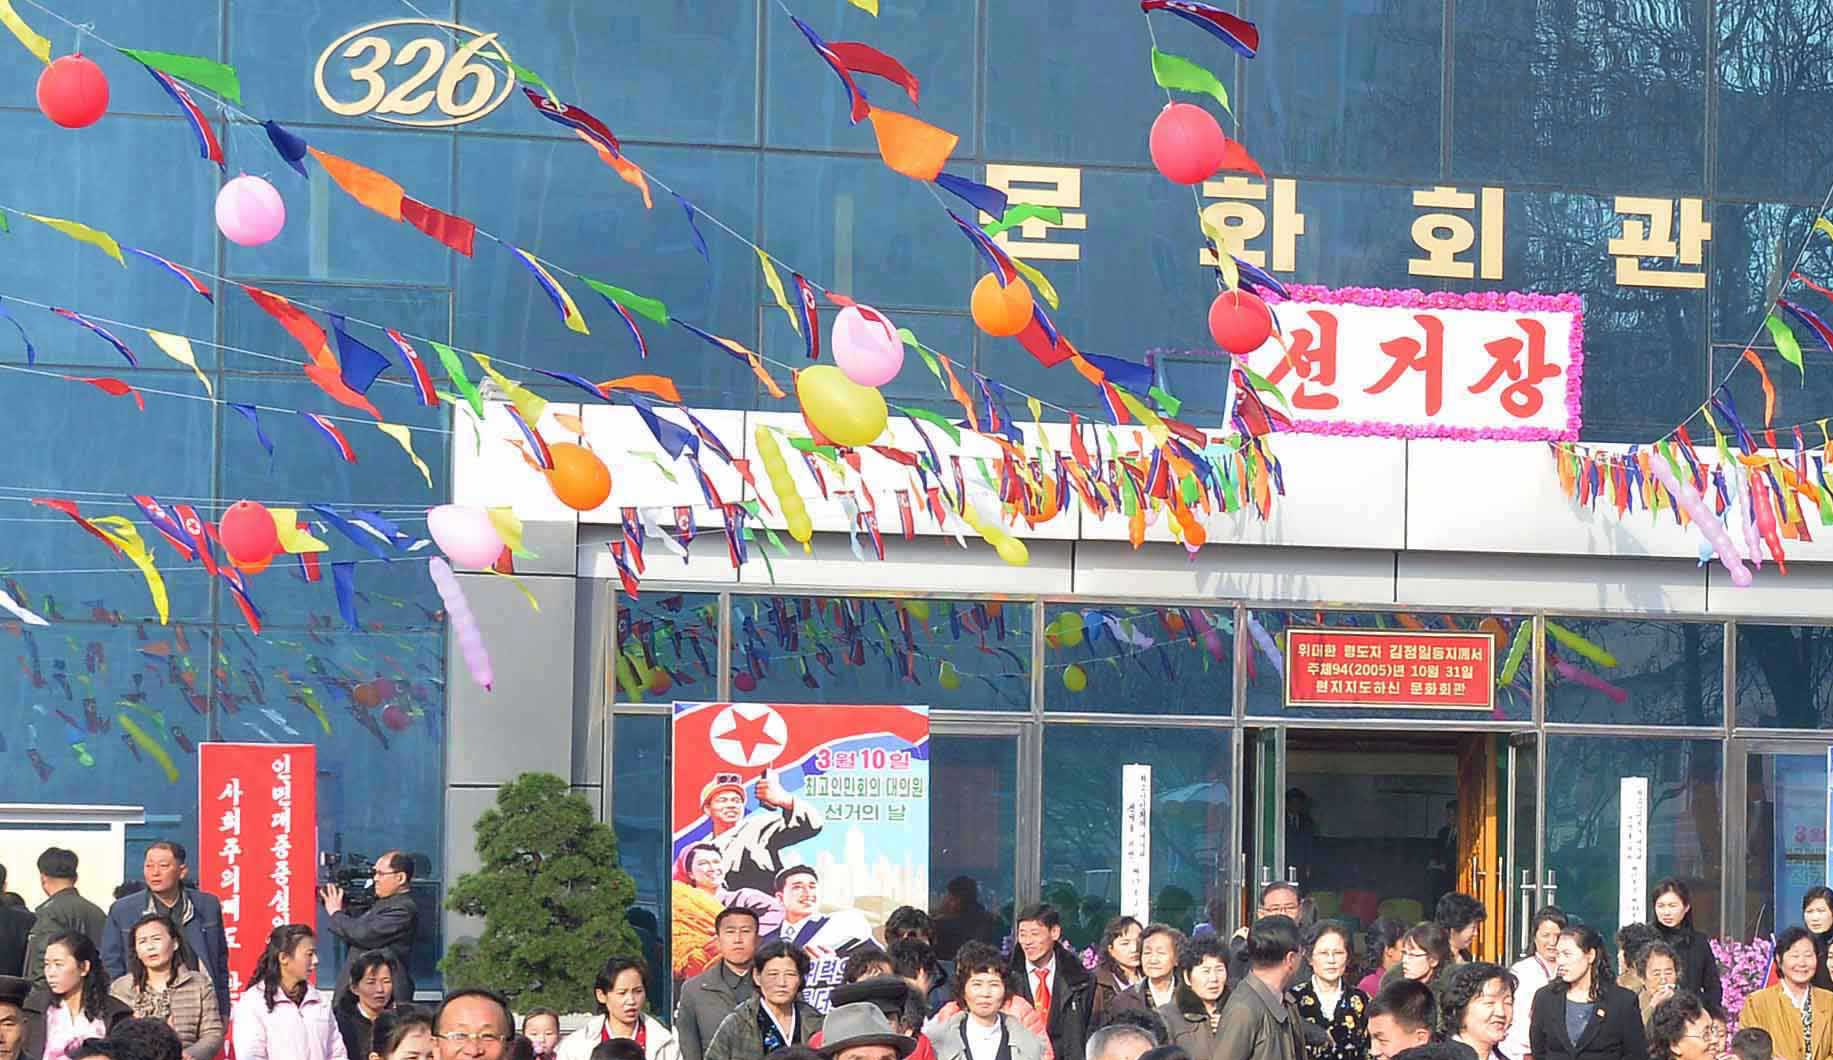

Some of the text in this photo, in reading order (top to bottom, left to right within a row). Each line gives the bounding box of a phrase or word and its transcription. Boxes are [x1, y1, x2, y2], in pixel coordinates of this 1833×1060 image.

[343, 33, 498, 117] 326
[1264, 310, 1562, 418] 선거장
[1298, 643, 1336, 658] 위대한
[1411, 665, 1439, 678] 10월
[1446, 665, 1473, 679] 31일
[1316, 680, 1466, 696] 현지지도하신 문화회관
[817, 749, 910, 769] 3월 10일
[805, 776, 924, 797] 최고인민회의 대의원
[825, 804, 906, 822] 선거의 날
